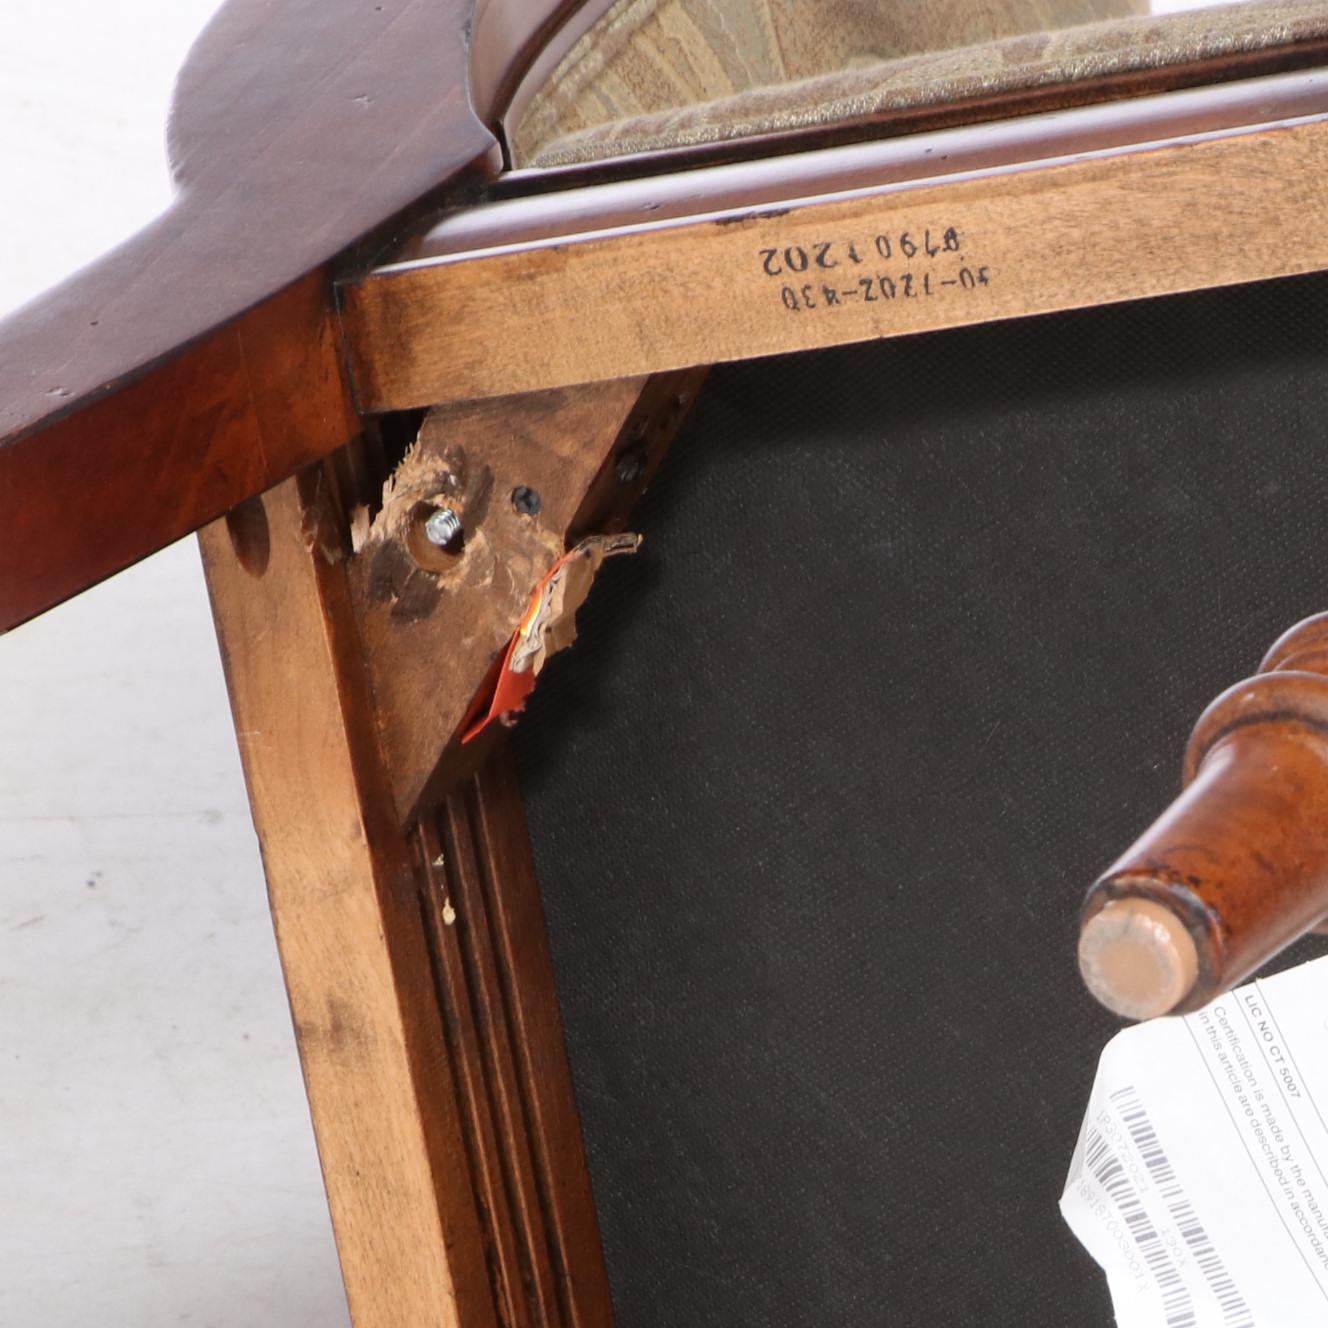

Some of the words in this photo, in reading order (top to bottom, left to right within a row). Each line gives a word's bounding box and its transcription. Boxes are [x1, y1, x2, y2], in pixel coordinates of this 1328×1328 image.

[1199, 1012, 1211, 1025] in
[1205, 1024, 1223, 1052] this
[1217, 1051, 1243, 1094] article
[1237, 1094, 1255, 1118] are
[1249, 1118, 1291, 1187] described
[1283, 1186, 1296, 1201] in
[1214, 1006, 1258, 1088] Certification
[1253, 1088, 1265, 1102] is
[1259, 1103, 1285, 1143] made
[1279, 1144, 1295, 1162] by
[1289, 1163, 1307, 1187] the
[1244, 995, 1263, 1018] LIC
[1257, 1020, 1274, 1043] NO
[1269, 1045, 1285, 1063] CT
[1279, 1067, 1301, 1098] 5007
